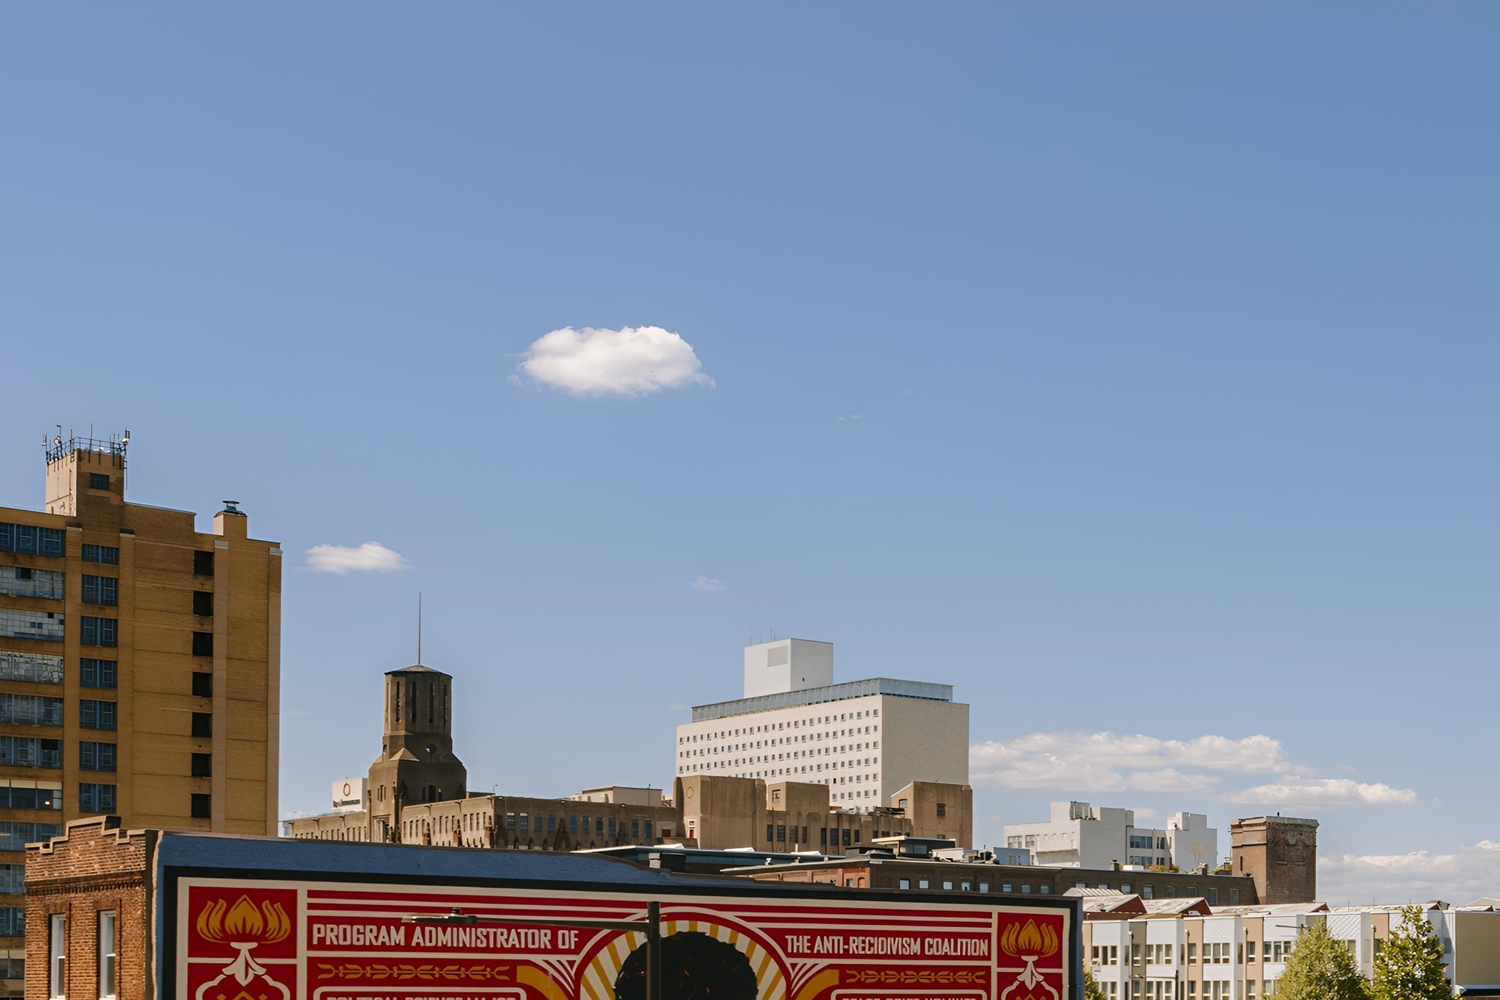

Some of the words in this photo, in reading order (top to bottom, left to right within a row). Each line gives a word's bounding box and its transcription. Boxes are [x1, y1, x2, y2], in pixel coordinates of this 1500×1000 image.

[312, 923, 405, 946] PROGRAM
[411, 926, 552, 949] ADMINISTRATOR
[557, 930, 579, 949] OF
[785, 935, 811, 953] THE
[814, 936, 921, 955] ANTI-RECIDIVISM
[925, 937, 988, 956] COALITION
